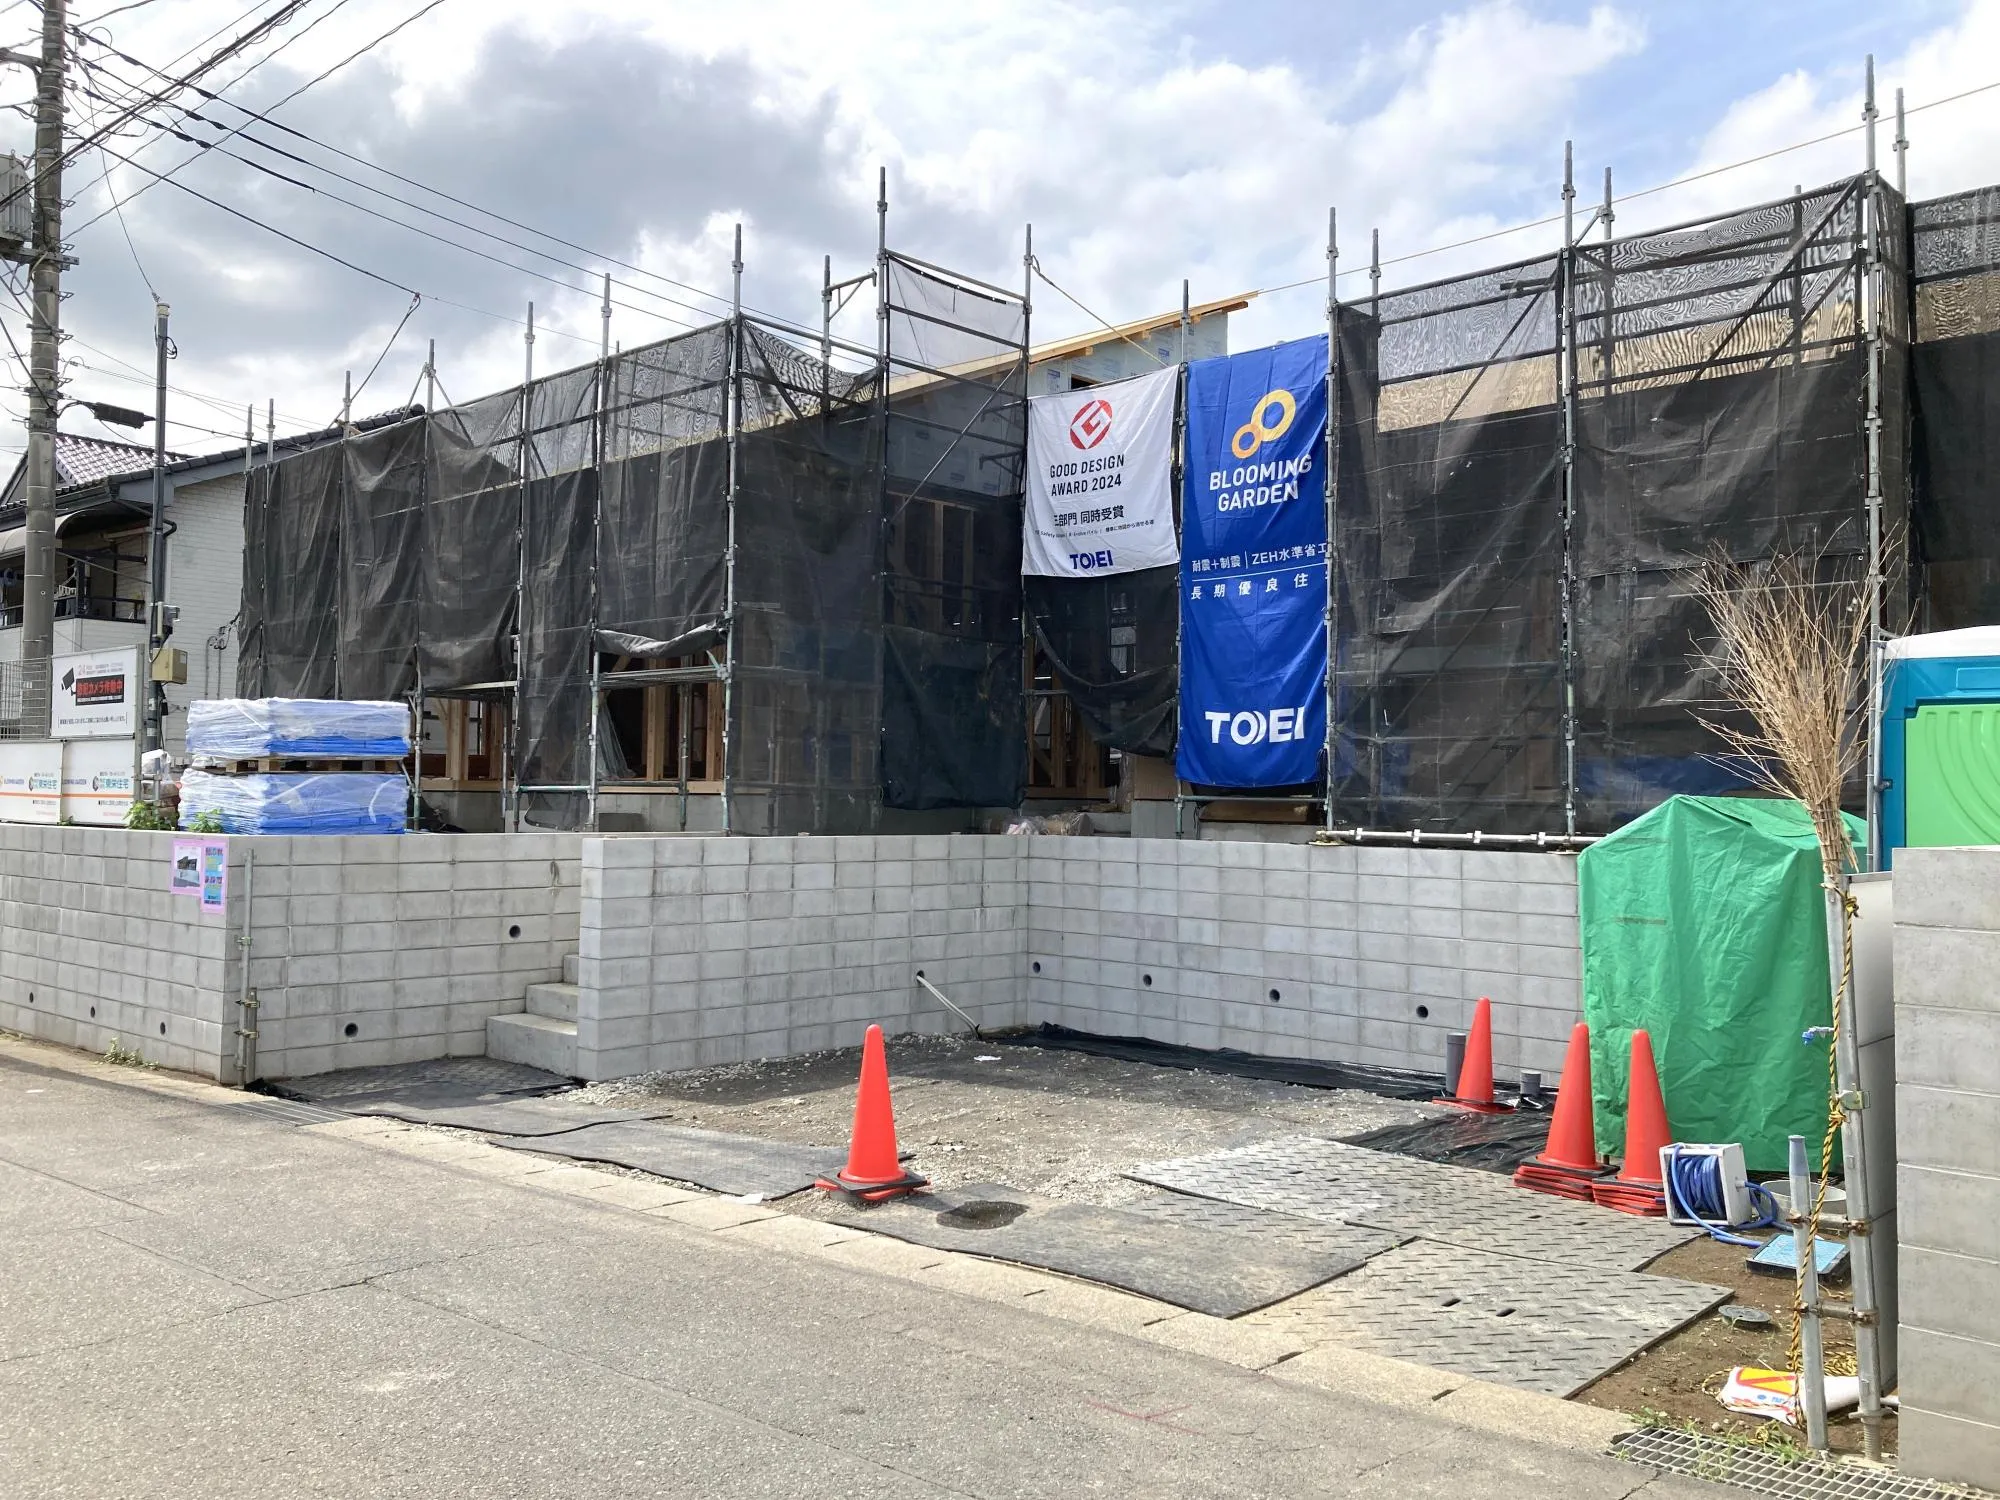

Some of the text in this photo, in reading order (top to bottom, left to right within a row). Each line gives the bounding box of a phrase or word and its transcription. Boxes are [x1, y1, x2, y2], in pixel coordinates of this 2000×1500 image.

[1050, 454, 1125, 478] GOOD DESIGN
[1209, 454, 1312, 491] BLOOMING
[1051, 473, 1122, 497] AWARD 2024
[1218, 480, 1299, 512] GARDEN
[1080, 504, 1124, 525] 同時受賞
[1069, 550, 1114, 570] TOEI
[1191, 569, 1327, 600] 長期優良住
[1204, 706, 1306, 746] TOEI
